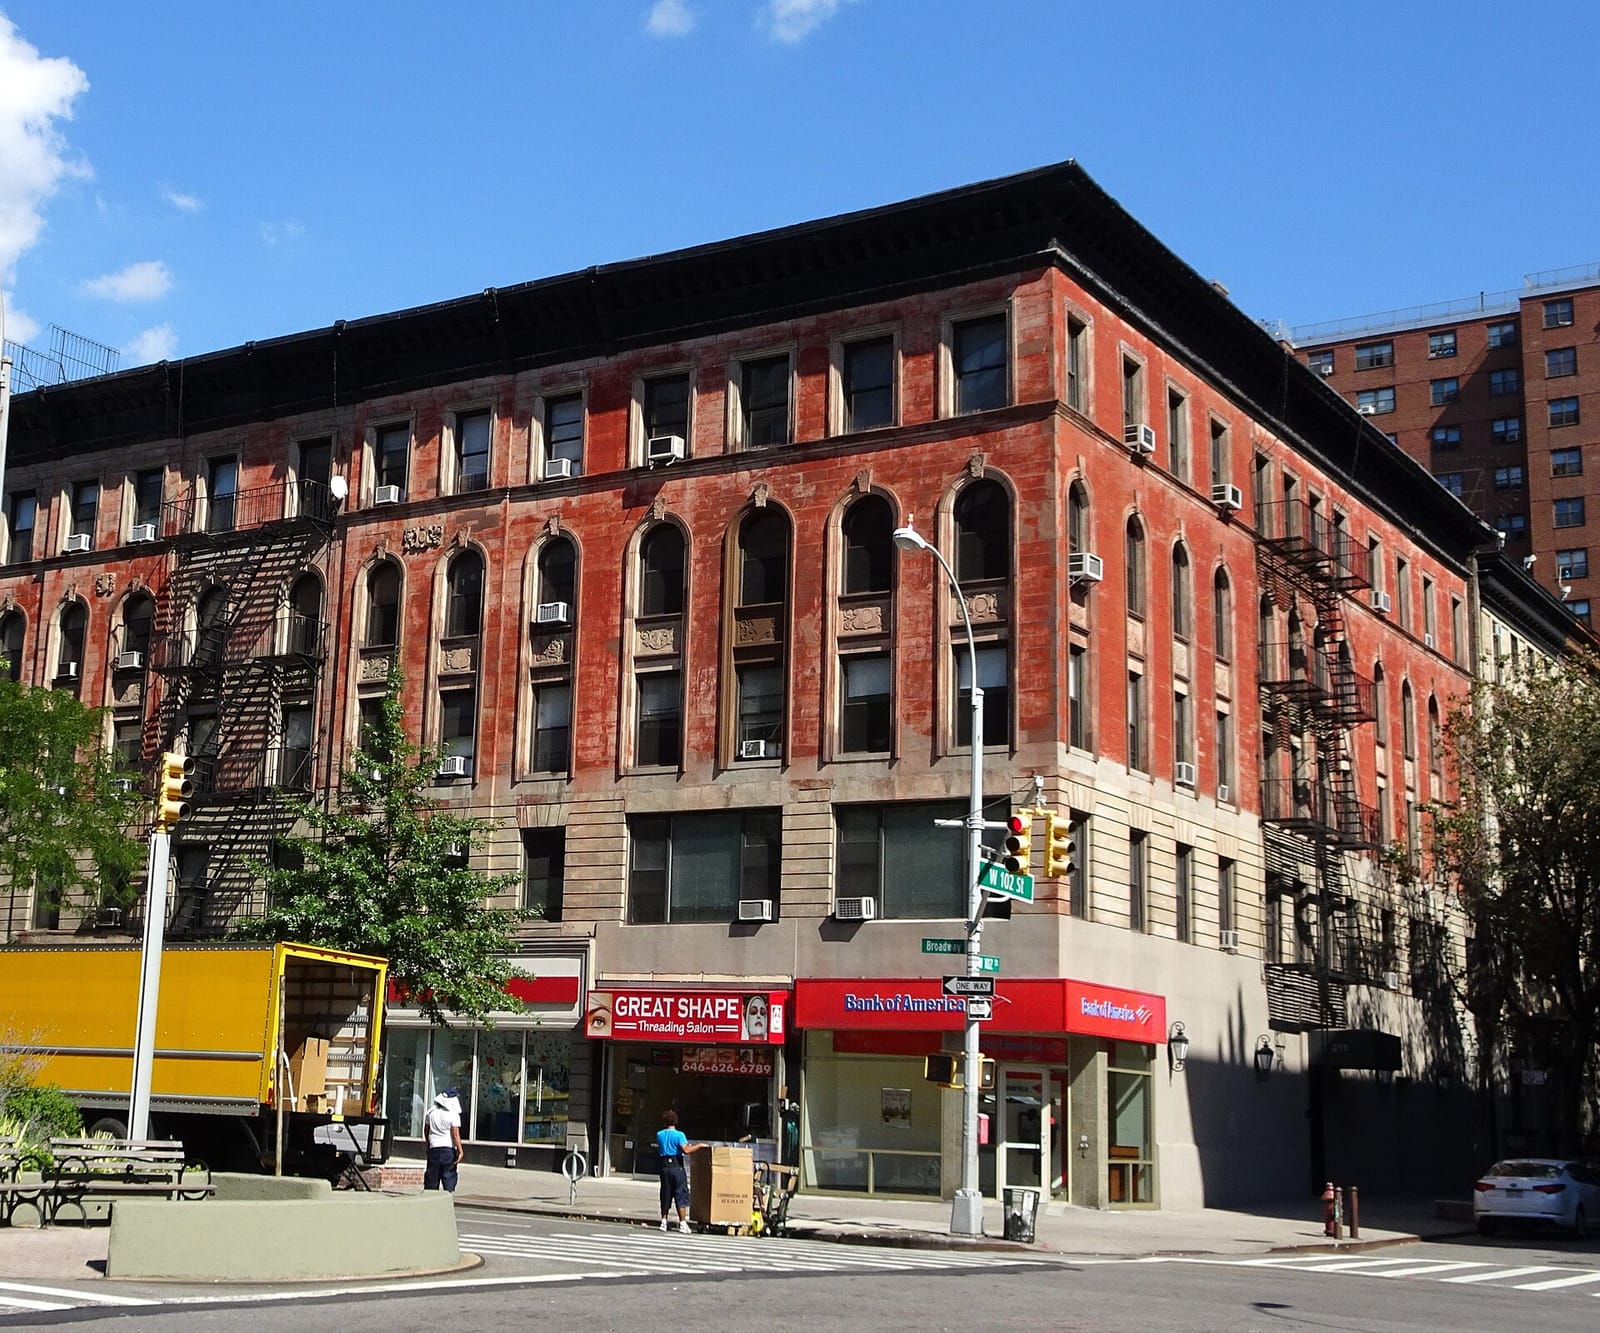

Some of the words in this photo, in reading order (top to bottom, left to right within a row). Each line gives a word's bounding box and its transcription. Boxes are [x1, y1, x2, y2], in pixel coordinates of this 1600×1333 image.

[989, 868, 998, 886] W
[1000, 872, 1014, 891] 102
[1015, 877, 1025, 895] St
[926, 940, 962, 953] Broadway
[956, 982, 970, 990] ONE
[973, 983, 989, 991] WAY
[615, 996, 675, 1018] GREAT
[678, 998, 739, 1019] SHAPE
[845, 994, 885, 1012] Bank
[886, 994, 901, 1011] of
[903, 994, 966, 1013] America
[638, 1020, 685, 1036] Threading
[686, 1021, 714, 1034] Salon
[682, 1061, 772, 1074] 646-626-6789
